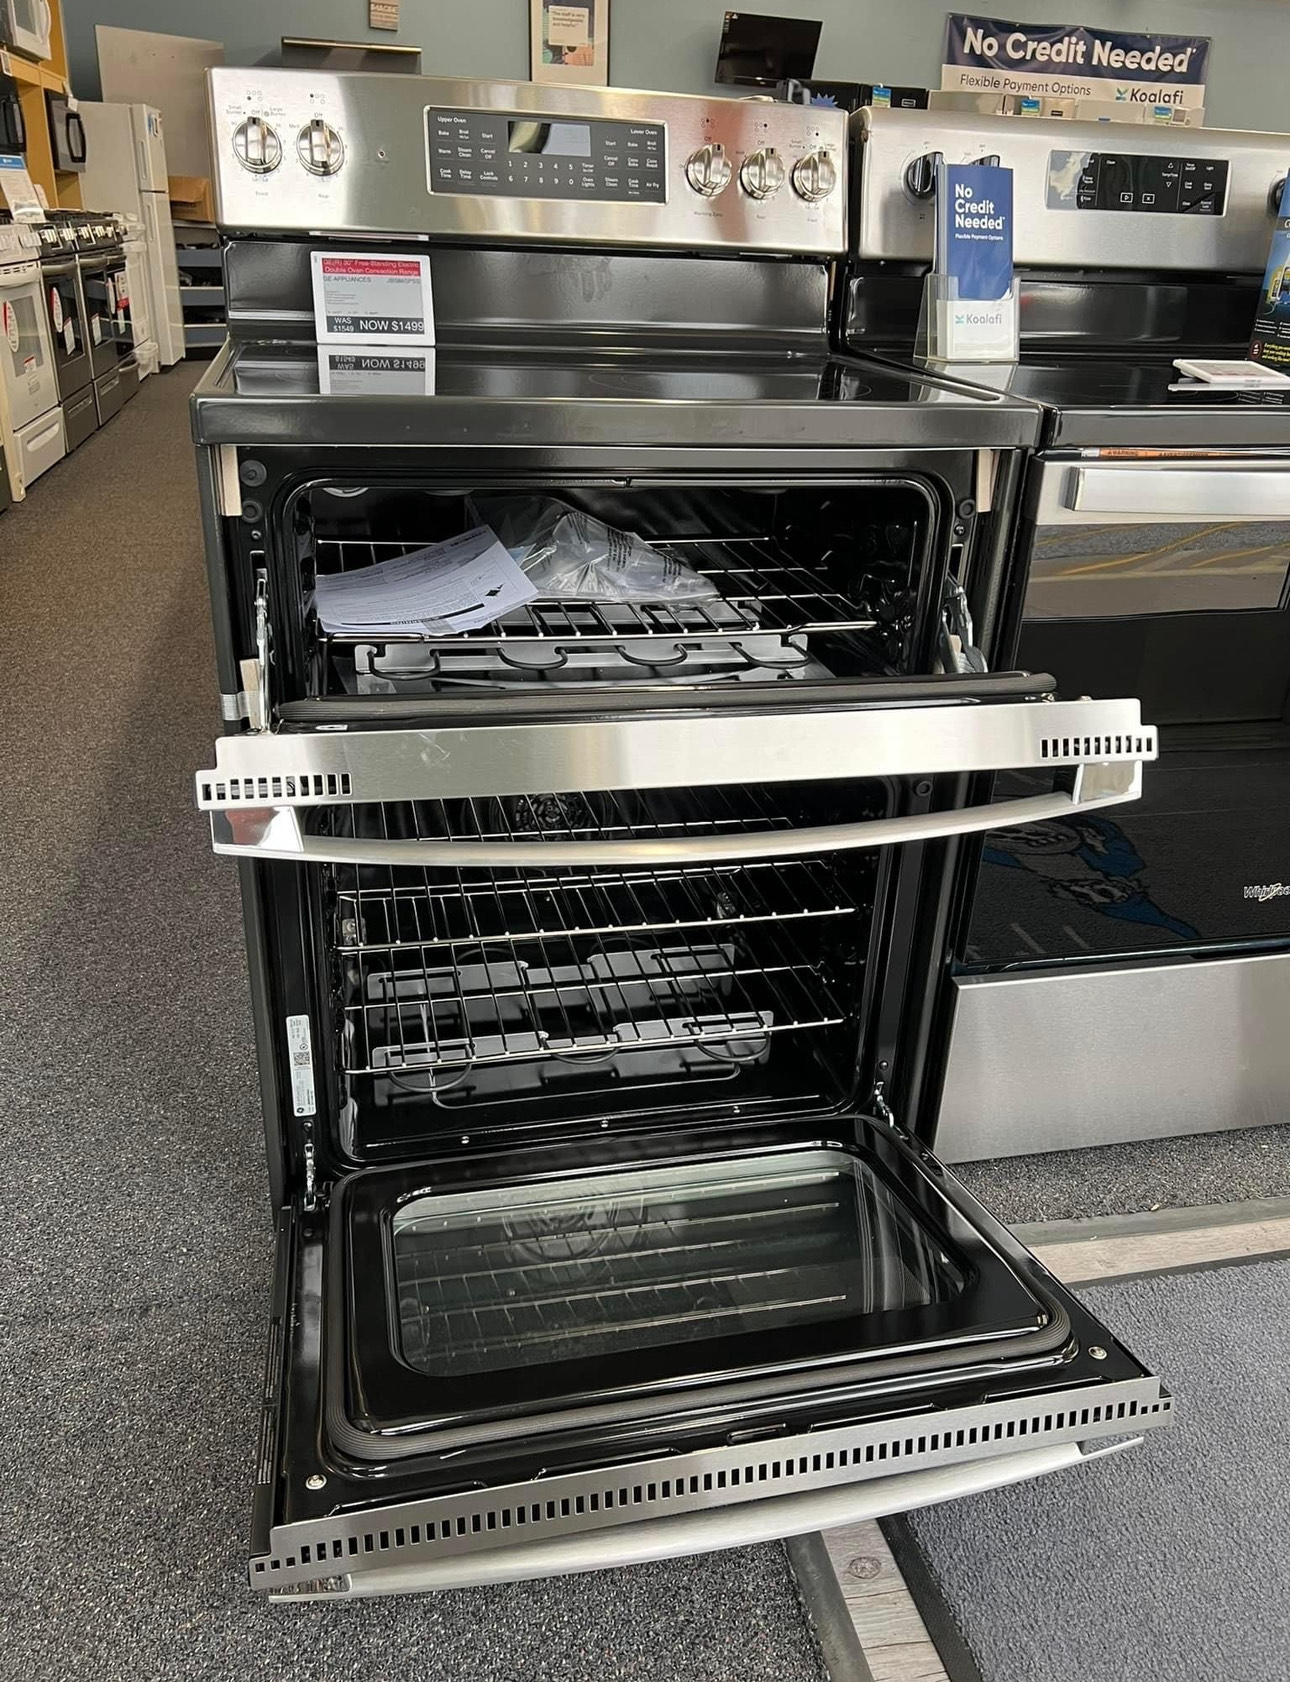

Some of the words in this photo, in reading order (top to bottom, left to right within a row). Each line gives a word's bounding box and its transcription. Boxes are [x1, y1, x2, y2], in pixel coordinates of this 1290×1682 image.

[963, 28, 998, 57] No
[1006, 33, 1087, 64] Credit
[960, 75, 1000, 88] Flexible
[1003, 80, 1049, 93] Payment
[1052, 83, 1091, 96] Options
[1130, 88, 1184, 104] Koalafi
[955, 184, 972, 198] No
[955, 200, 994, 214] Credit
[360, 320, 389, 330] NOW
[392, 322, 424, 331] $1499
[966, 314, 1002, 324] Koalafi
